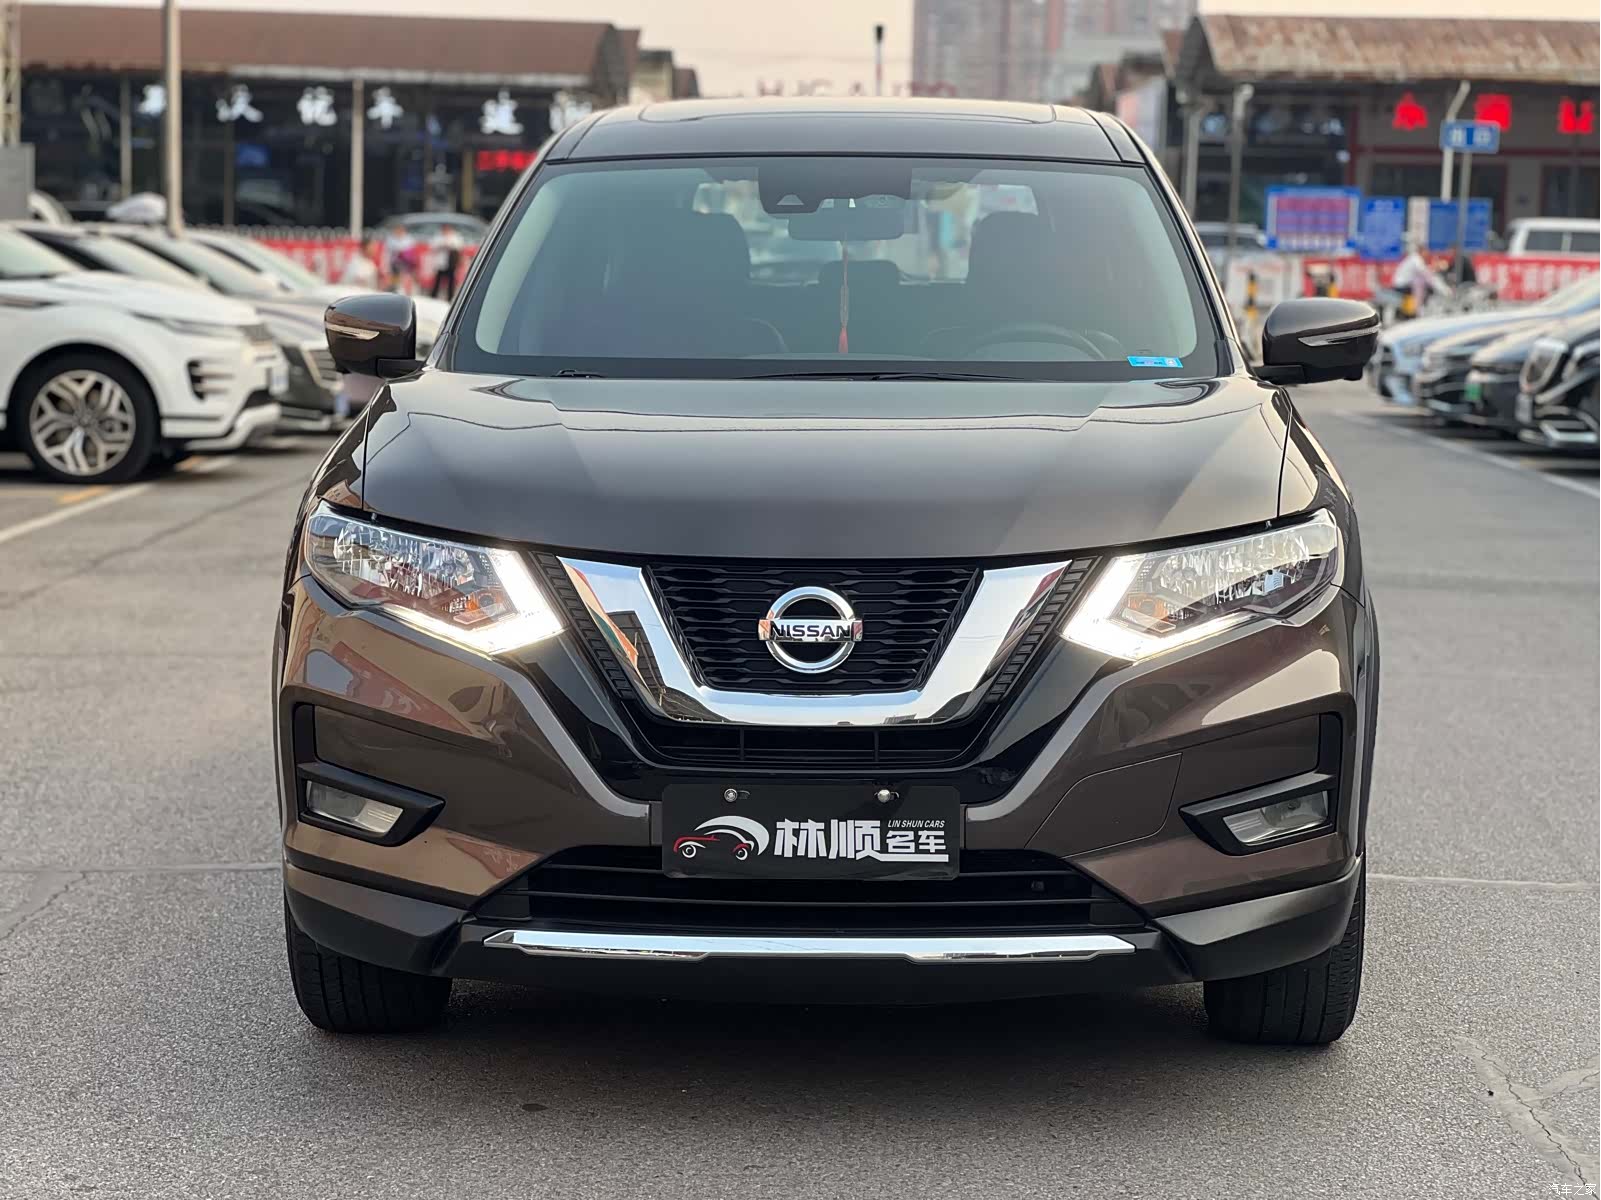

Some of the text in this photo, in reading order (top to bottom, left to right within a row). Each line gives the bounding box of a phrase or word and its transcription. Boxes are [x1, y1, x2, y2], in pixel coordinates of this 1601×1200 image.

[770, 622, 851, 638] NISSAN
[887, 819, 946, 829] LIN SHUN CARS
[774, 818, 947, 861] 林顺 名车
